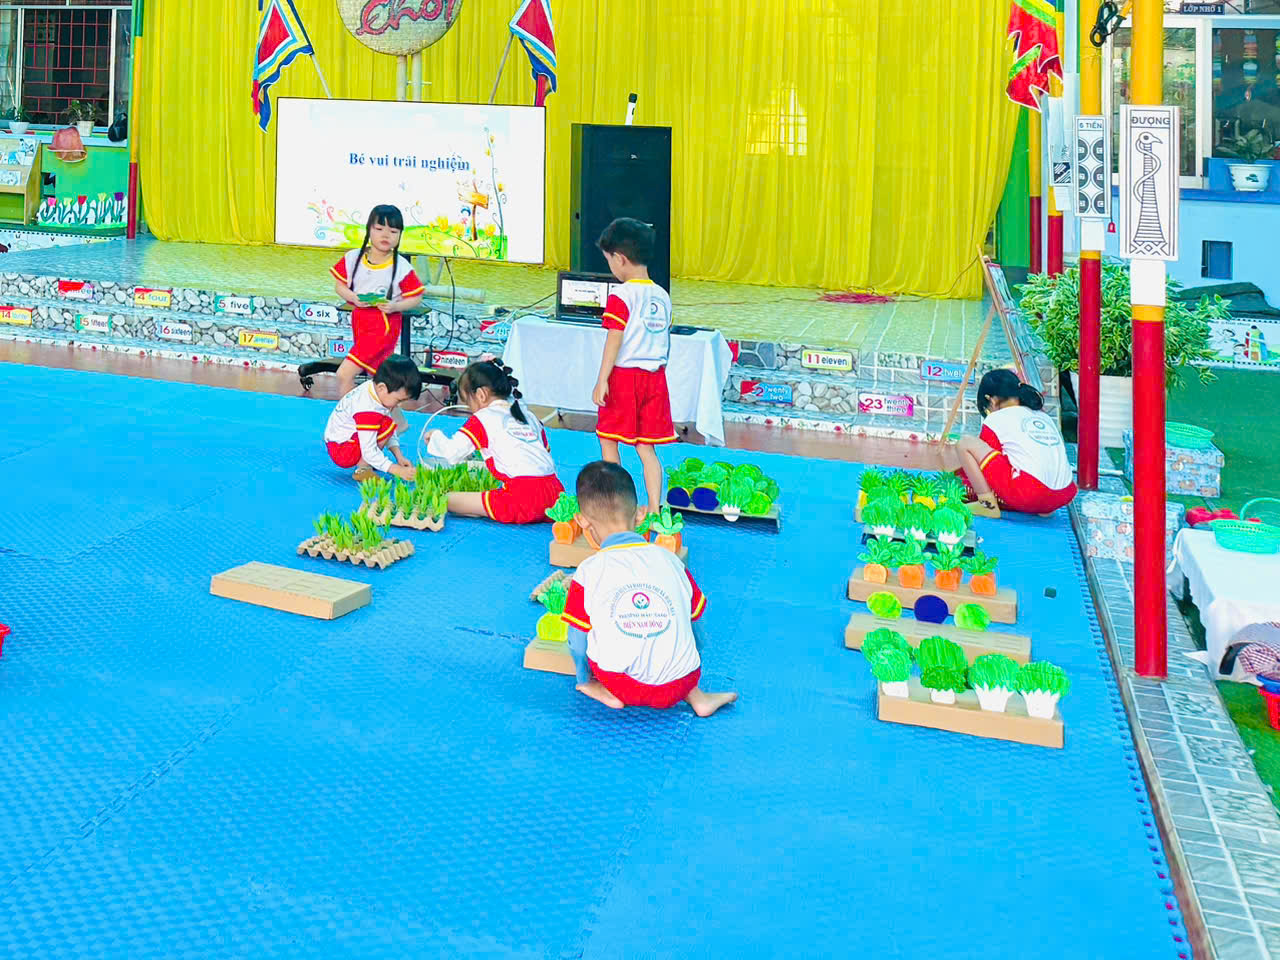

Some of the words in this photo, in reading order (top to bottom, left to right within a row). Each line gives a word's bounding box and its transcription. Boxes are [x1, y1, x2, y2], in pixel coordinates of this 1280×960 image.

[1131, 116, 1170, 126] ĐƯỢNG
[350, 153, 365, 165] Bé
[370, 154, 389, 166] vui
[148, 293, 167, 302] four
[219, 300, 226, 308] 5
[230, 301, 249, 310] five
[1, 311, 11, 319] 14
[305, 307, 313, 317] 6
[316, 309, 331, 318] six
[80, 318, 90, 326] 15
[159, 325, 170, 335] 16
[243, 334, 254, 343] 17
[333, 343, 345, 353] 18
[807, 353, 820, 364] 11
[821, 356, 848, 366] eleven
[927, 365, 942, 377] 12
[944, 368, 966, 378] twelv
[864, 398, 883, 410] 23
[886, 405, 907, 413] three
